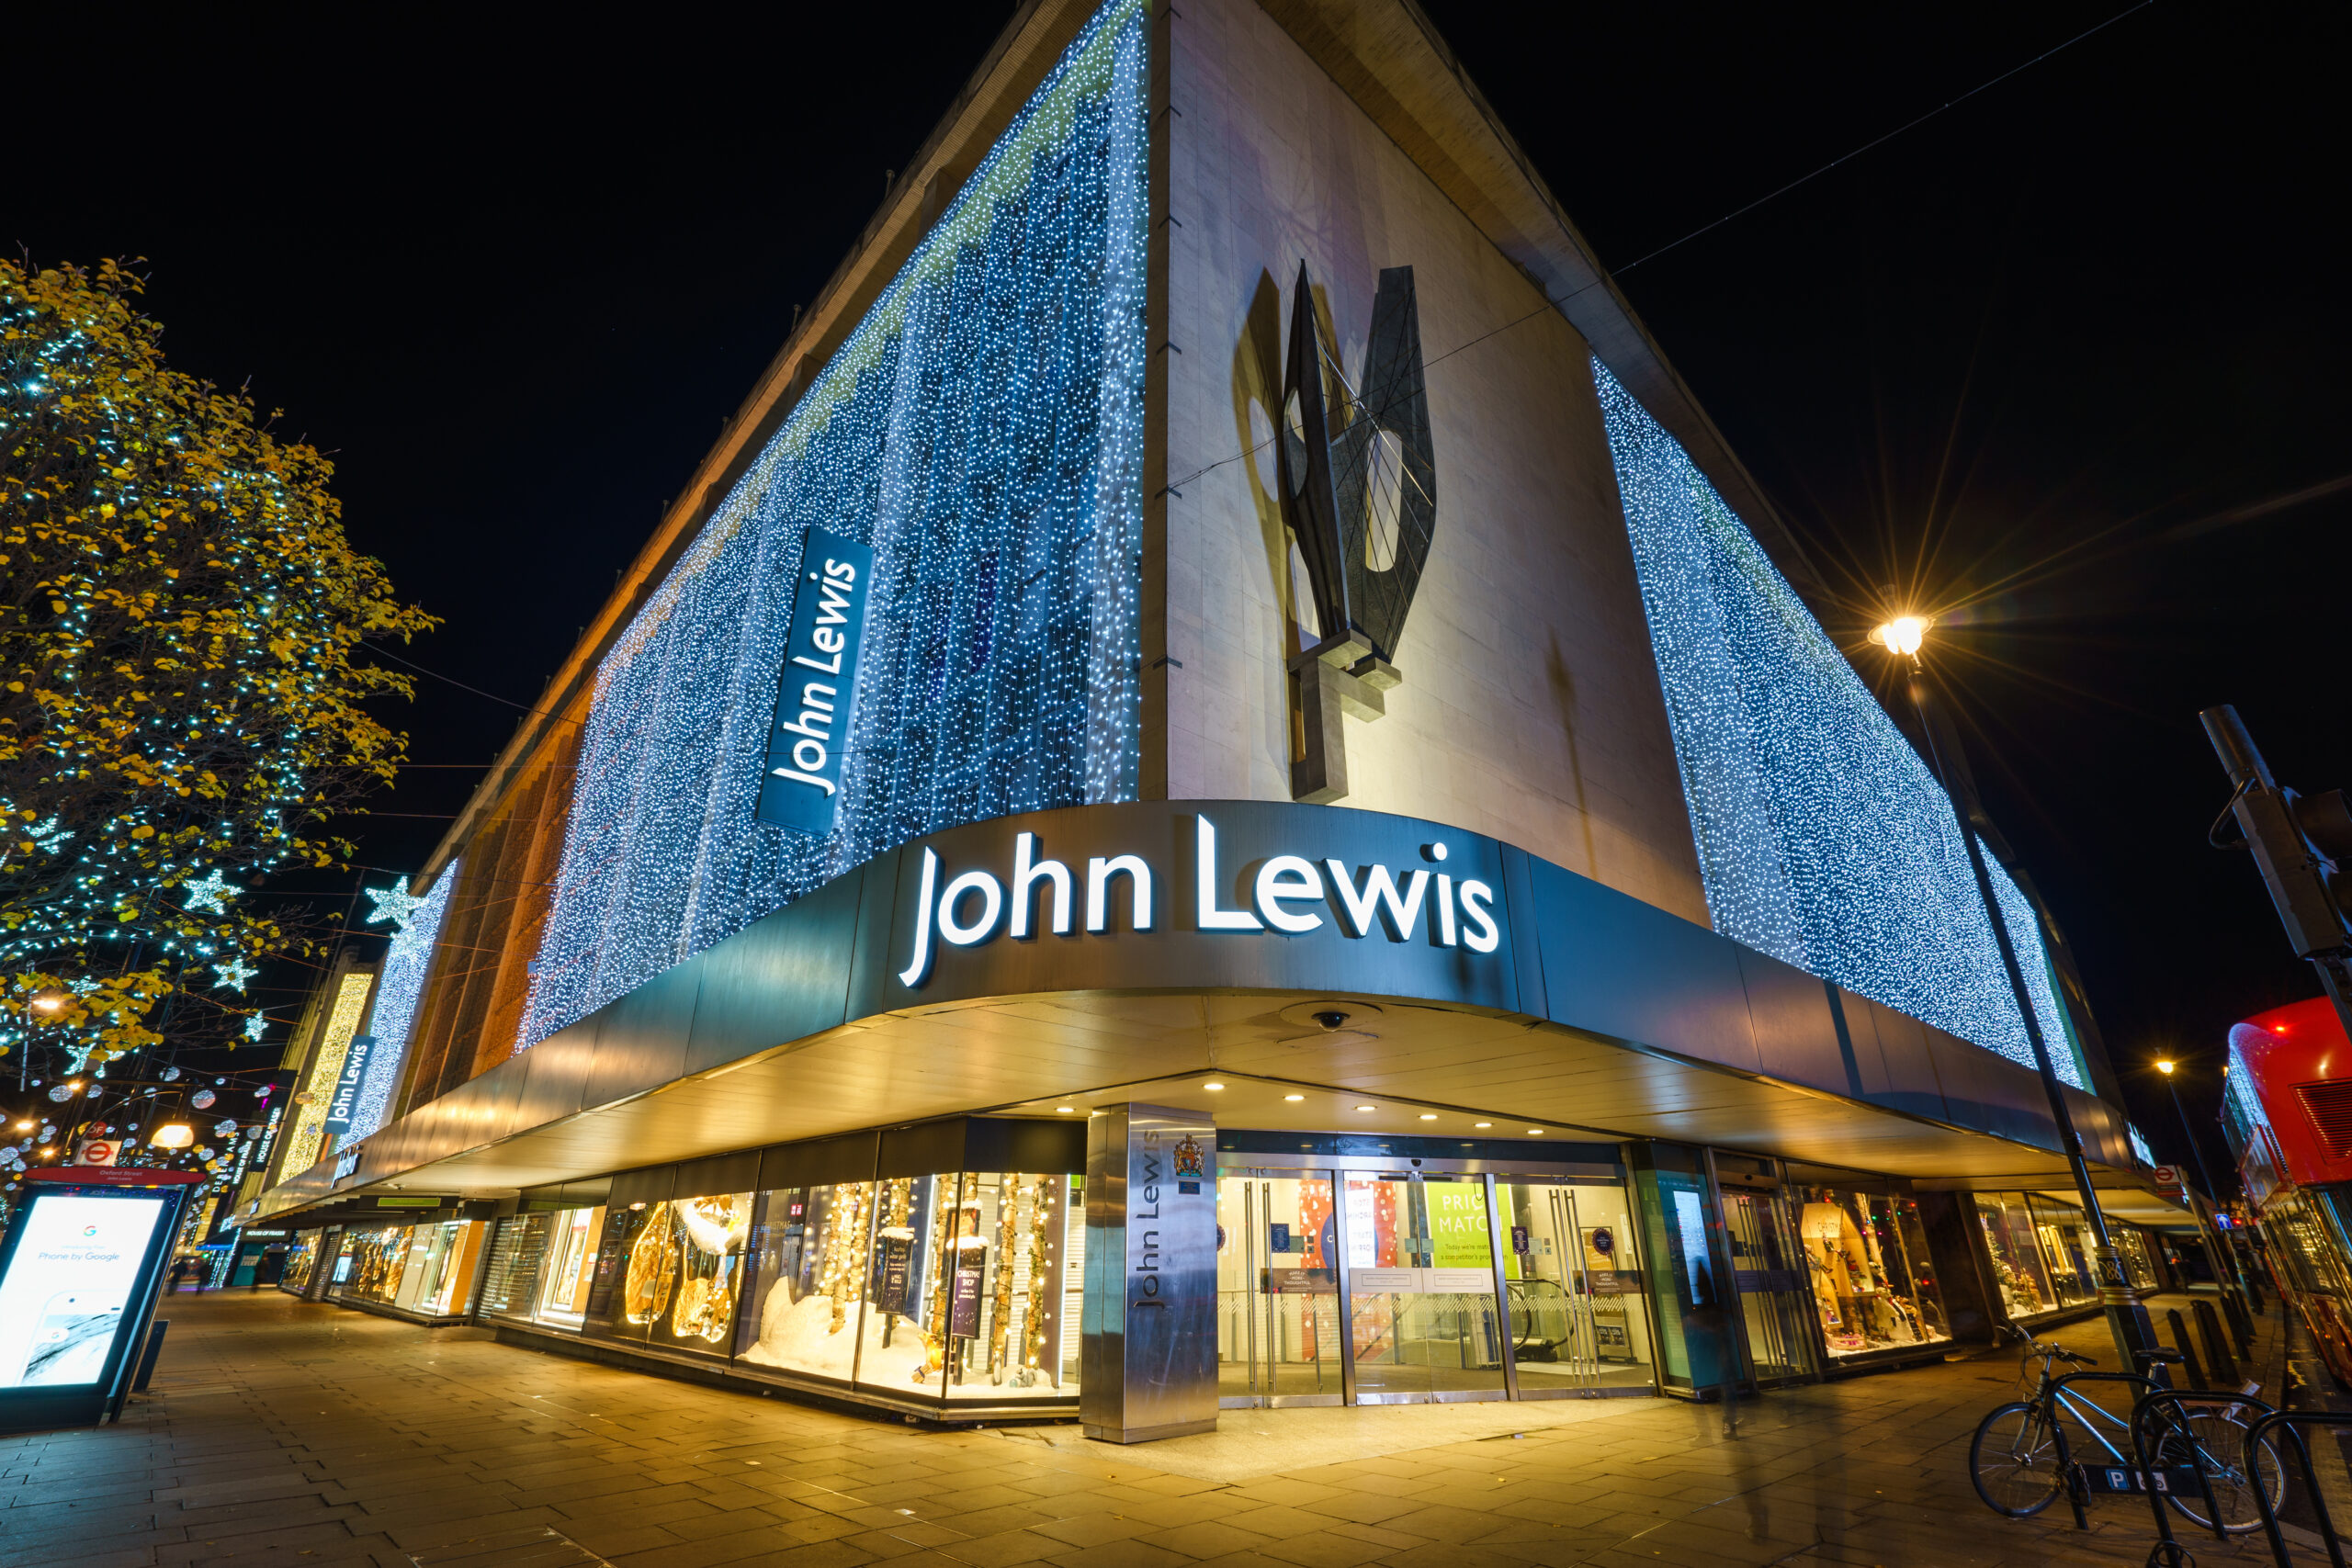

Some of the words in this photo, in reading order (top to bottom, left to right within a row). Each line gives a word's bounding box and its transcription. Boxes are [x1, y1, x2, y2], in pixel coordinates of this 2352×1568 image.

[791, 558, 855, 675] Lewis
[770, 682, 837, 796] John
[898, 831, 1152, 987] John
[1197, 812, 1499, 954] Lewis
[338, 1044, 368, 1085] Lewis
[326, 1088, 356, 1124] John
[212, 1131, 240, 1192] DEBENAMS
[255, 1139, 271, 1164] HOUSE
[1136, 1130, 1160, 1219] Lewis
[1442, 1193, 1486, 1211] PRIC
[1439, 1215, 1503, 1233] MATC
[38, 1252, 68, 1260] Phone
[71, 1253, 83, 1261] by
[85, 1251, 119, 1261] Google
[1133, 1231, 1165, 1310] John
[2110, 1472, 2124, 1488] P
